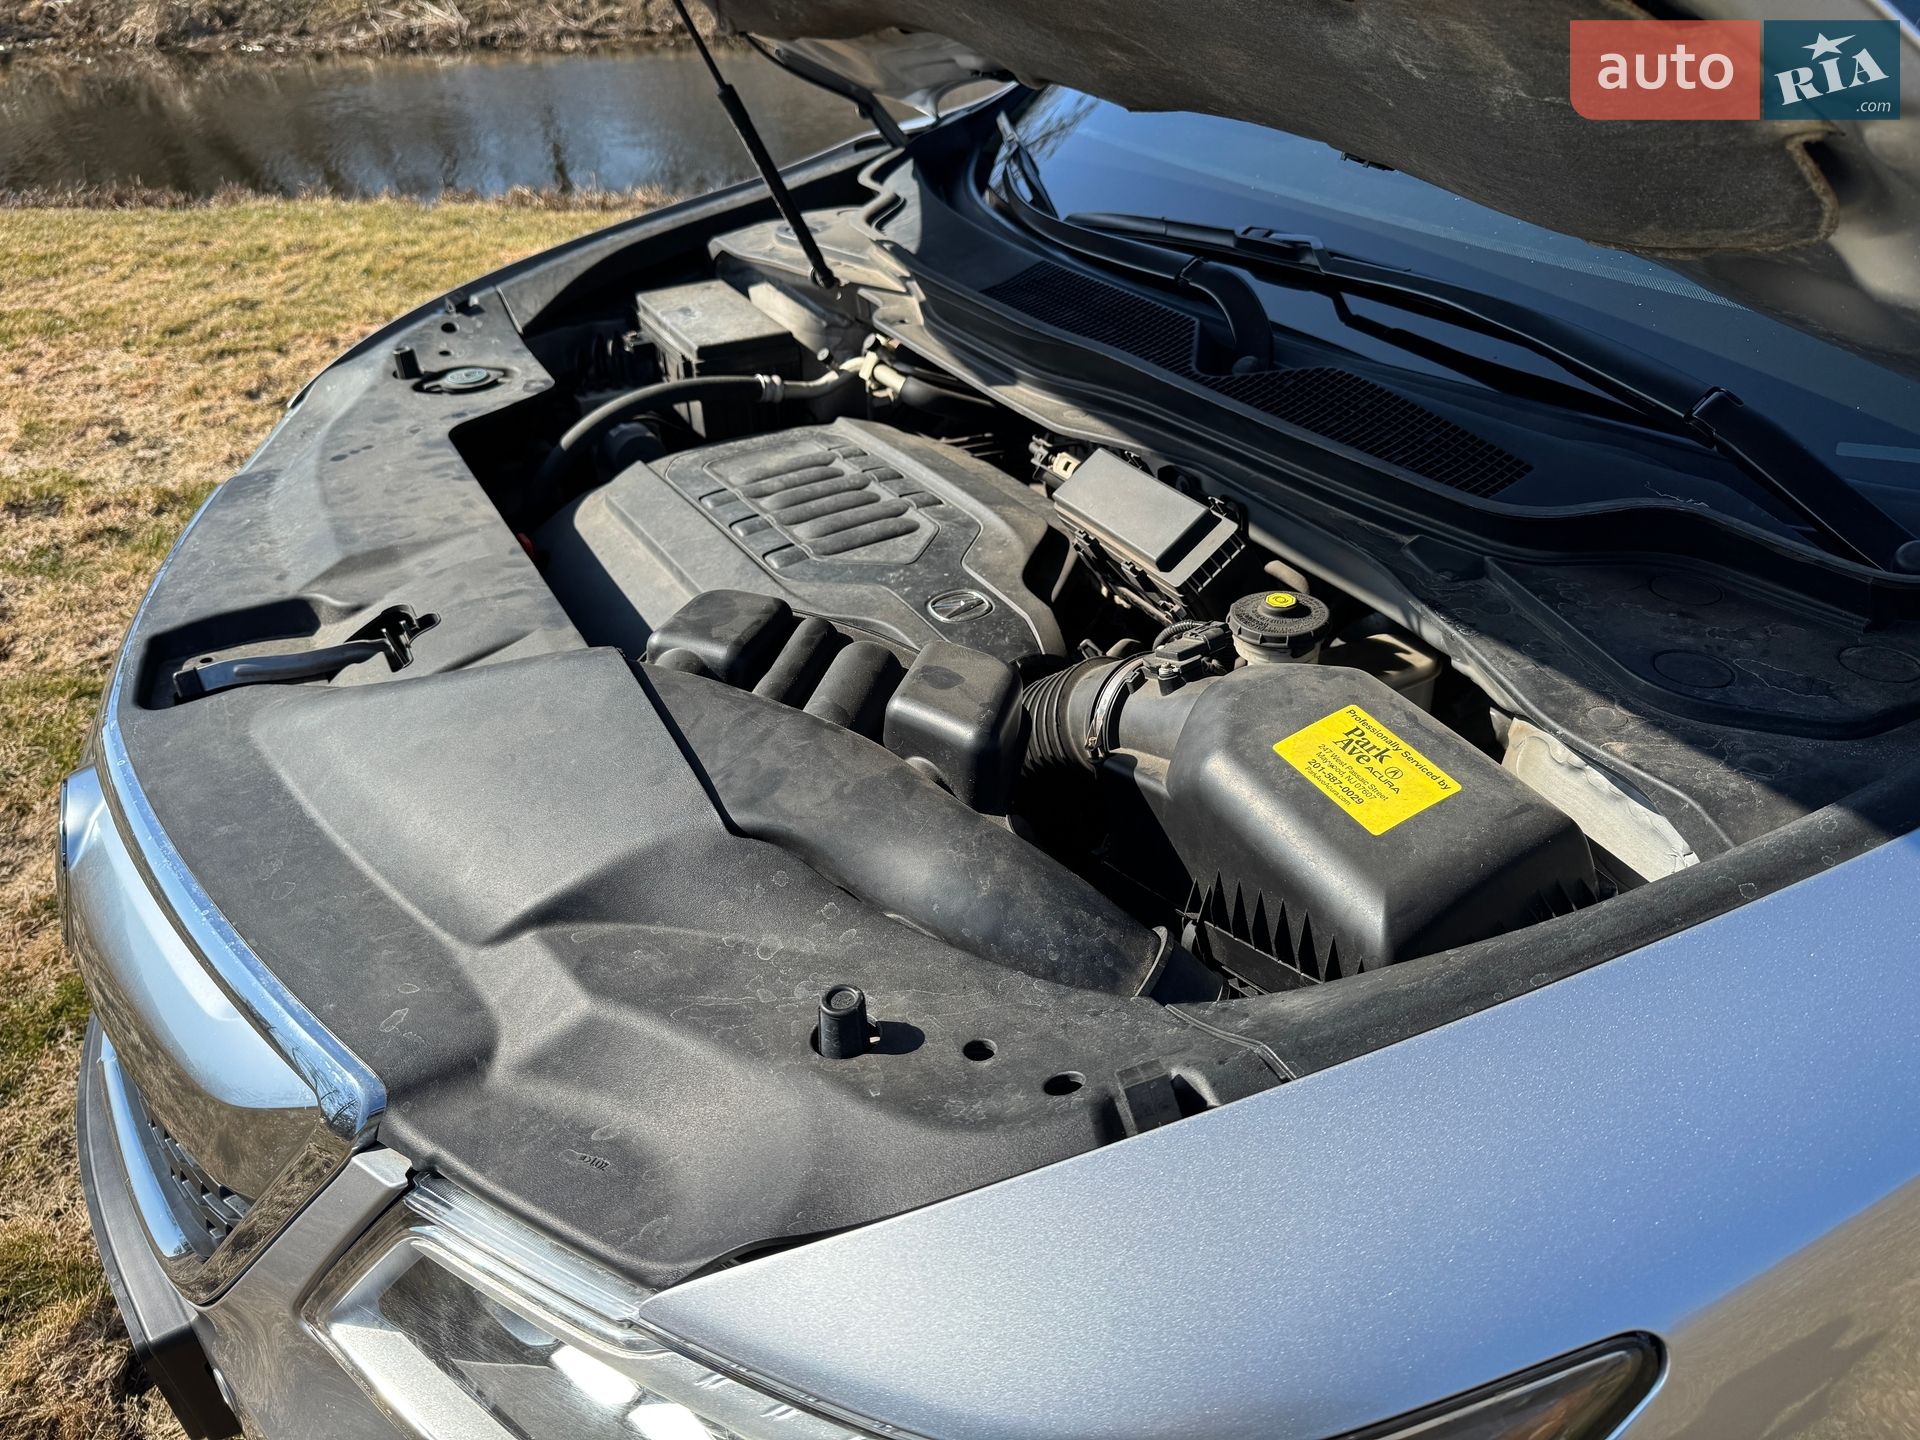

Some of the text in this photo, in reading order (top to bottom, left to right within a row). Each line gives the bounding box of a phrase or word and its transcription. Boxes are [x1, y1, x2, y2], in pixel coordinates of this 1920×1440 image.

[1332, 737, 1400, 794] Ave ACURA
[1343, 725, 1392, 764] Park
[1346, 709, 1451, 790] Professionally Serviced by
[1304, 766, 1352, 806] ParkAveAcura.com
[1307, 758, 1365, 805] 201-587-0029
[1315, 751, 1376, 800] Maywood, NJ 07607
[1318, 743, 1389, 801] 247 West Passaic Street
